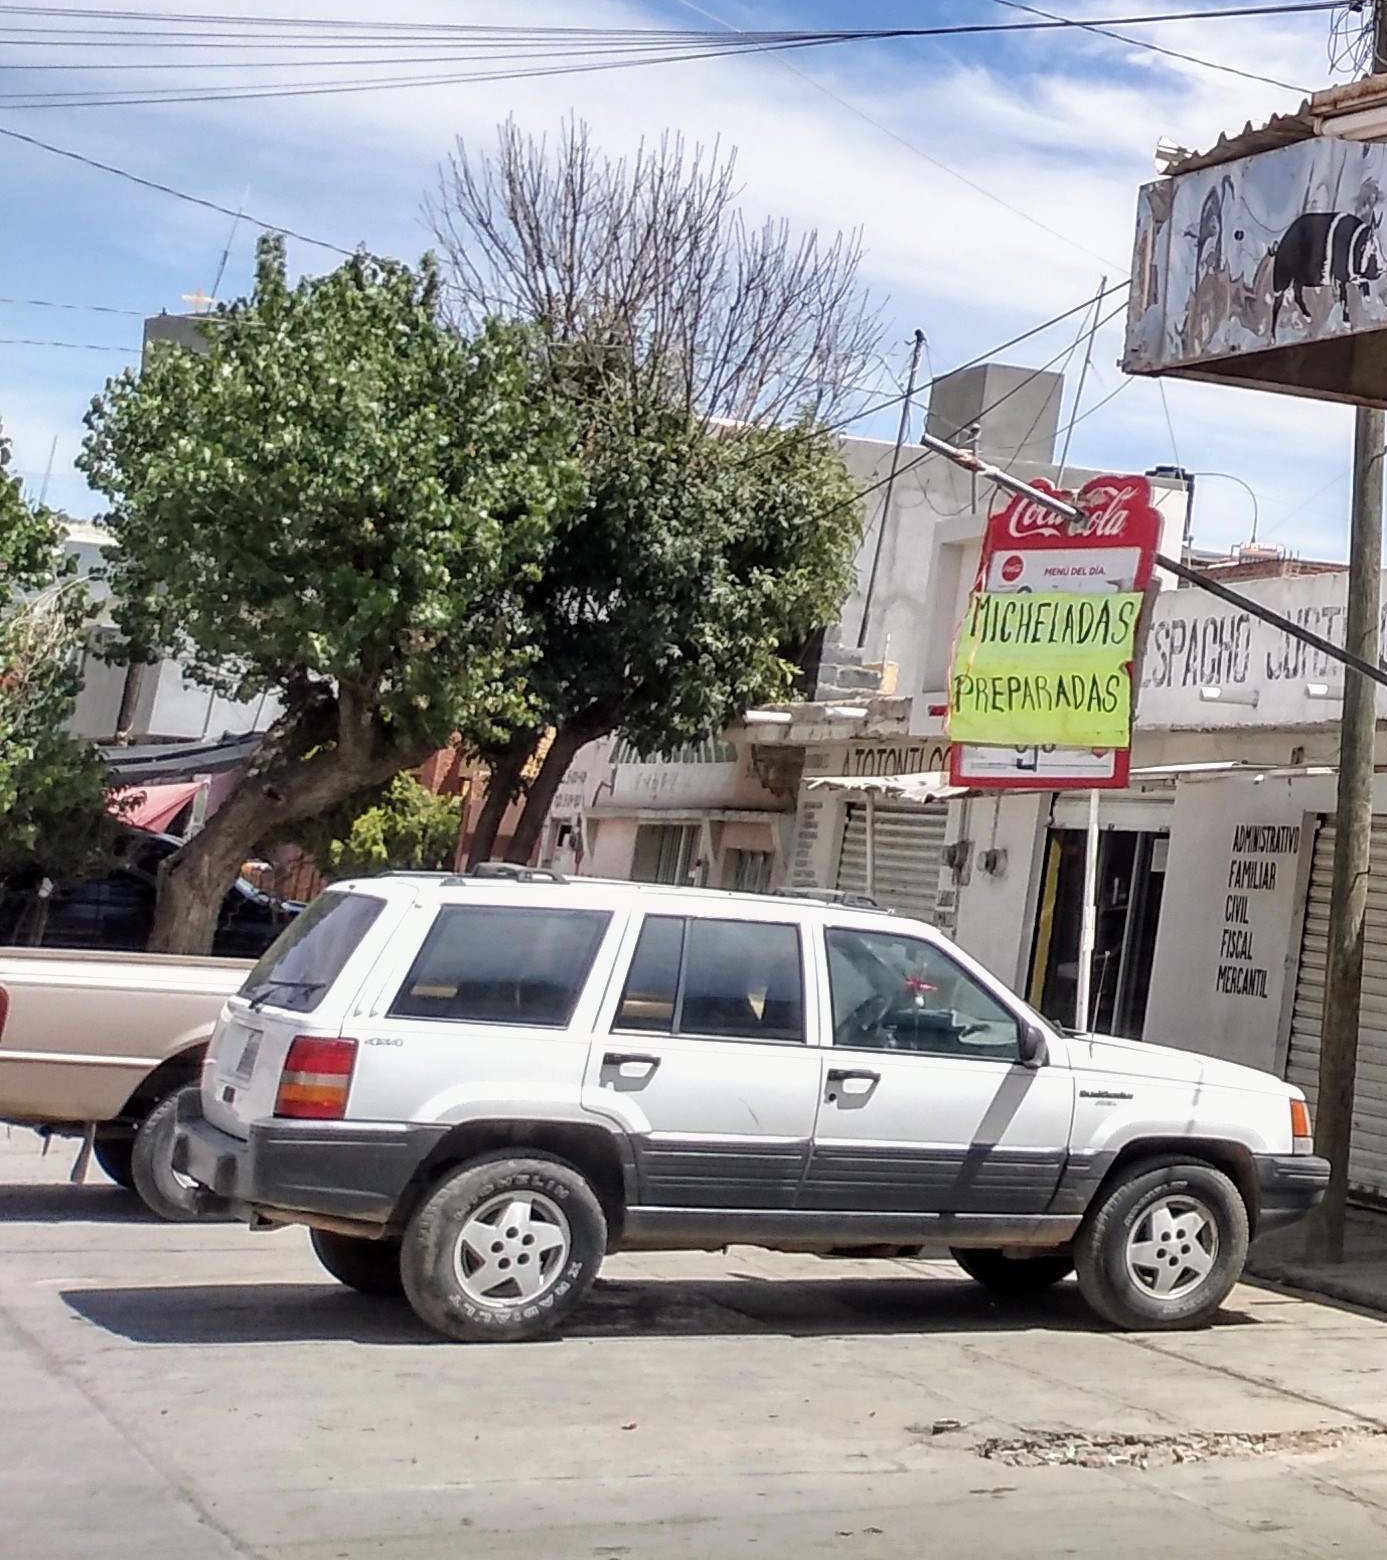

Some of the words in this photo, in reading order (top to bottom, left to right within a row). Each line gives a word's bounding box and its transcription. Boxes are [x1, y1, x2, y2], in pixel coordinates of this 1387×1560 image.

[970, 594, 1135, 645] MICHELADAS
[1143, 613, 1251, 689] SPACHO
[954, 672, 1120, 714] PREPARADAS
[1232, 825, 1300, 854] ADMINISTRATIVO
[1228, 860, 1277, 890] FAMILIAR
[1225, 894, 1249, 924] CIVIL
[1220, 929, 1253, 960] FISCAL
[1216, 965, 1268, 998] MERCANTIL
